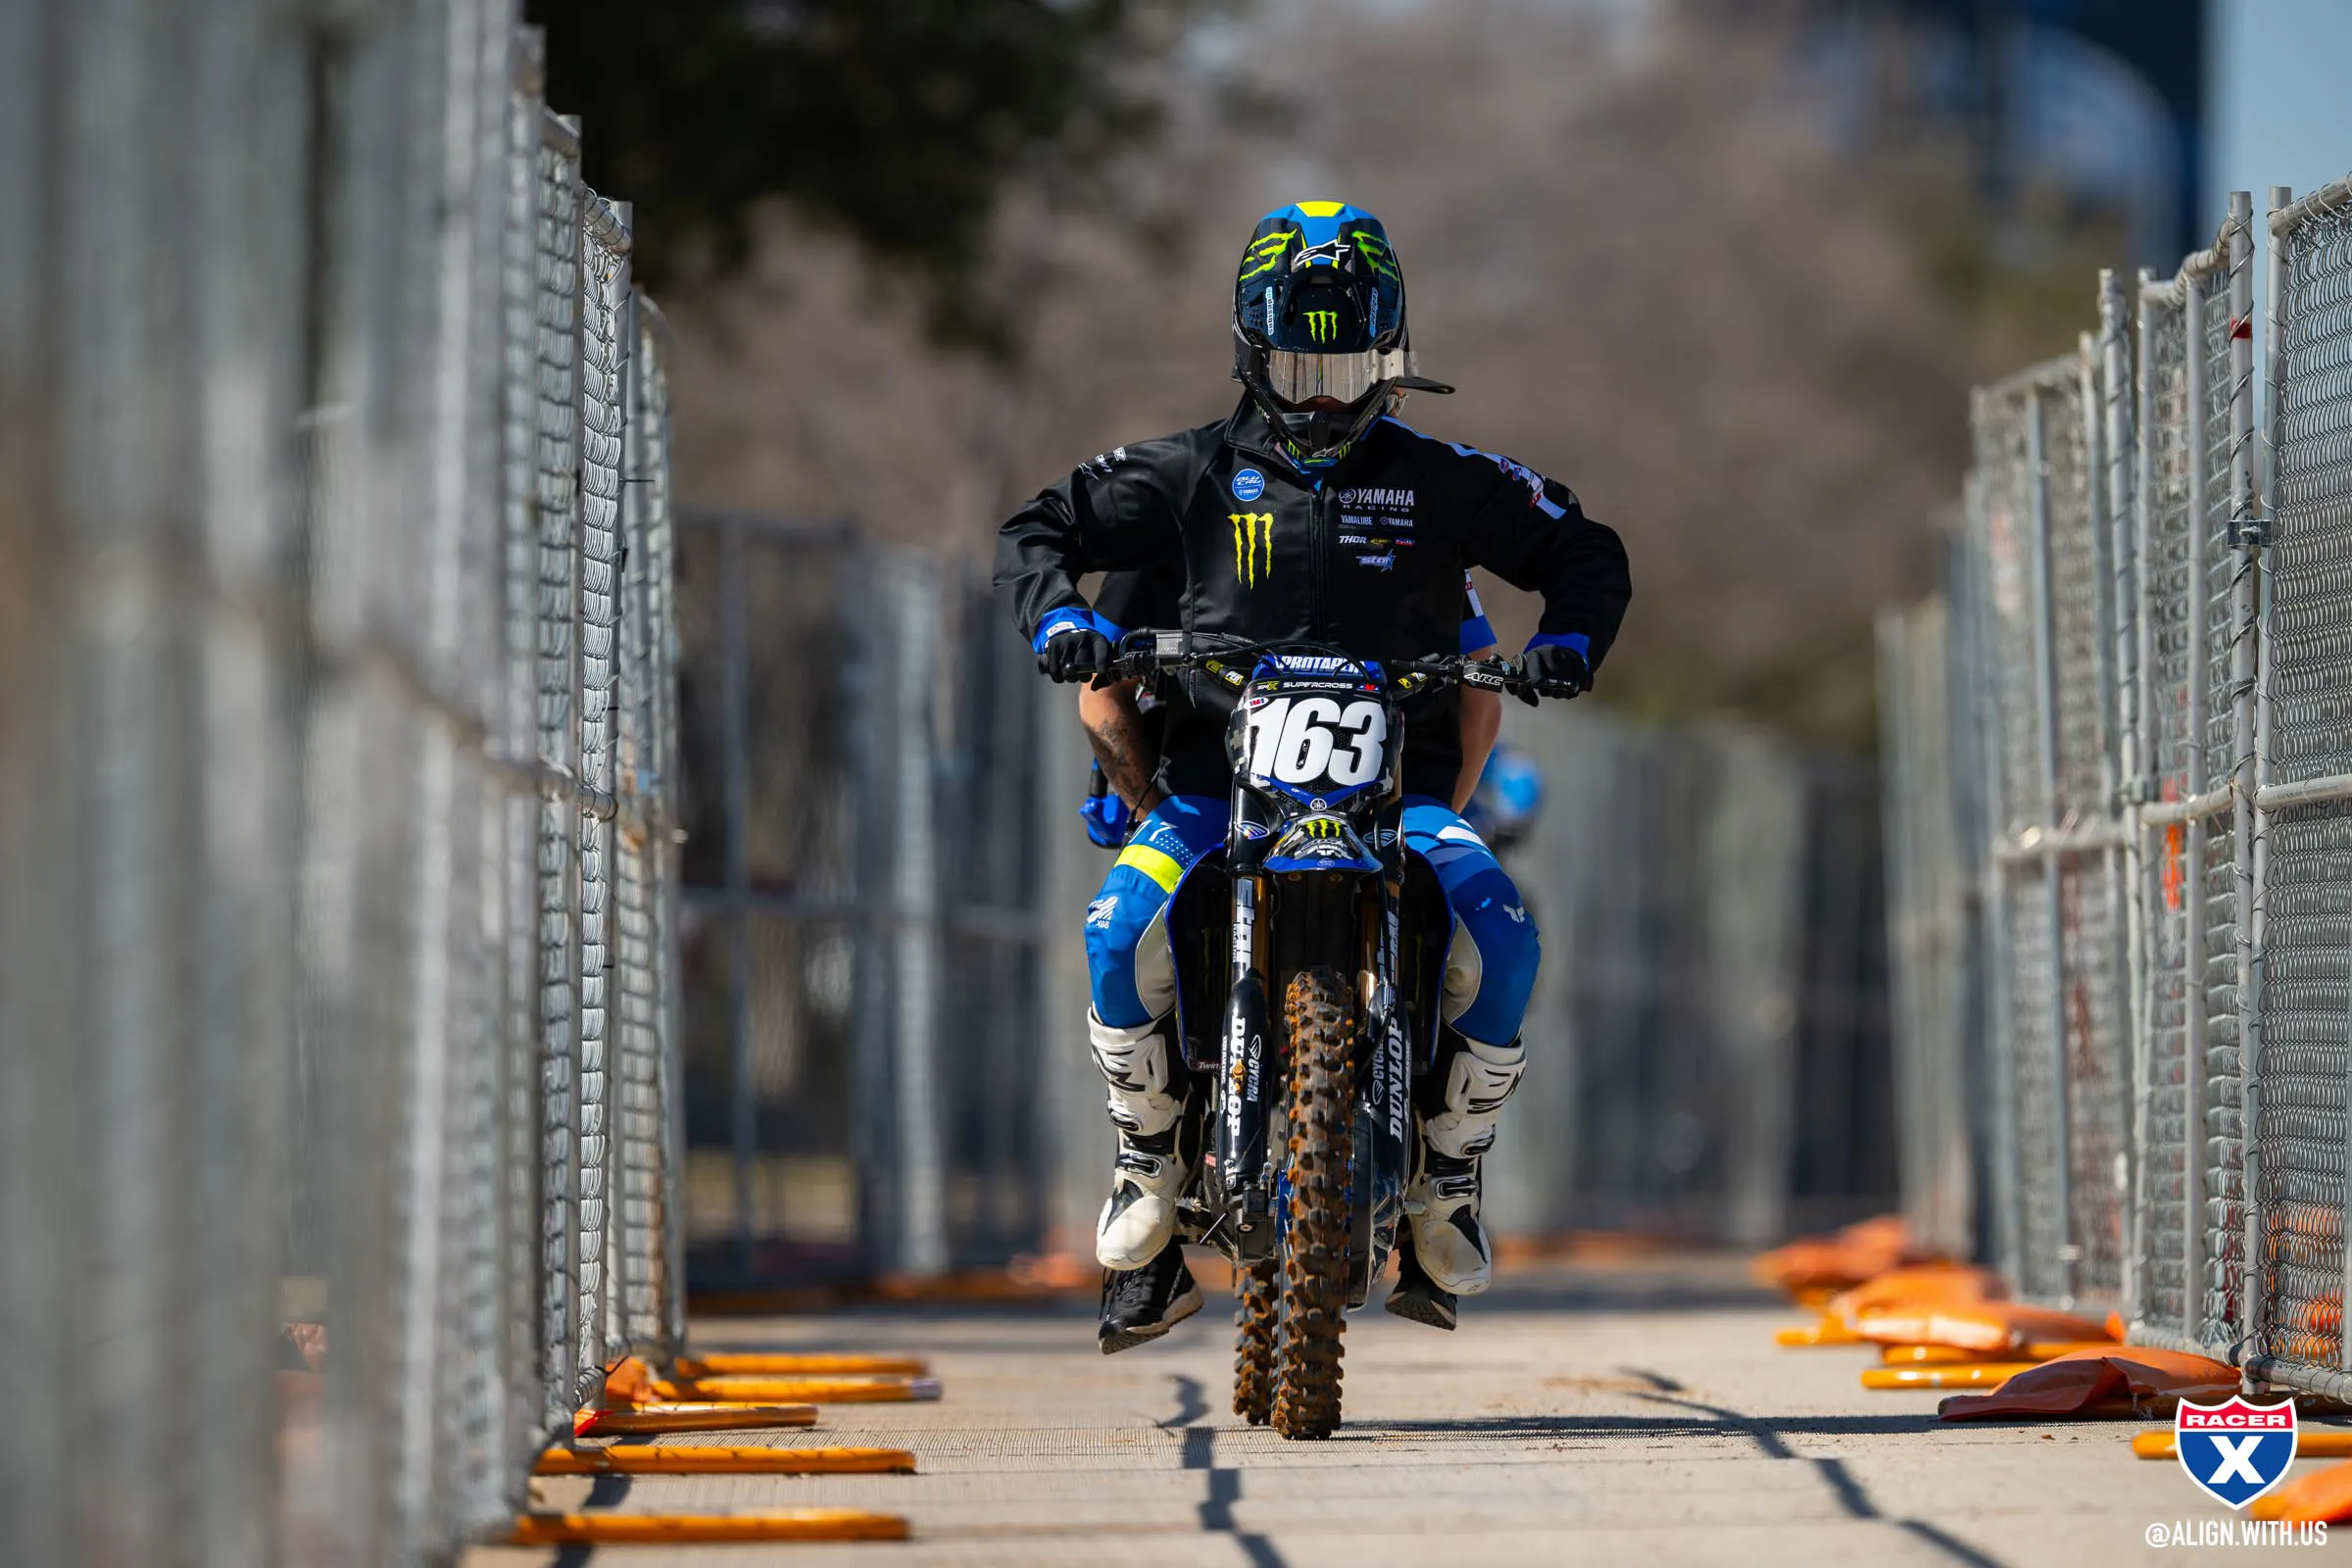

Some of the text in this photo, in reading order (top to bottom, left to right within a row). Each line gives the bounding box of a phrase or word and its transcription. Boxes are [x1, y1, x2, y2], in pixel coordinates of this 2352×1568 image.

[1357, 488, 1414, 506] YAMAHA
[1343, 504, 1409, 513] RACING
[1340, 514, 1373, 525] YAMALUBE
[1388, 517, 1413, 527] YAMAHA
[1339, 535, 1367, 544] THOR
[1464, 671, 1504, 686] ARC
[1250, 697, 1387, 786] 163
[1247, 1058, 1260, 1102] CYCRA
[1389, 1016, 1402, 1144] DUNLOP
